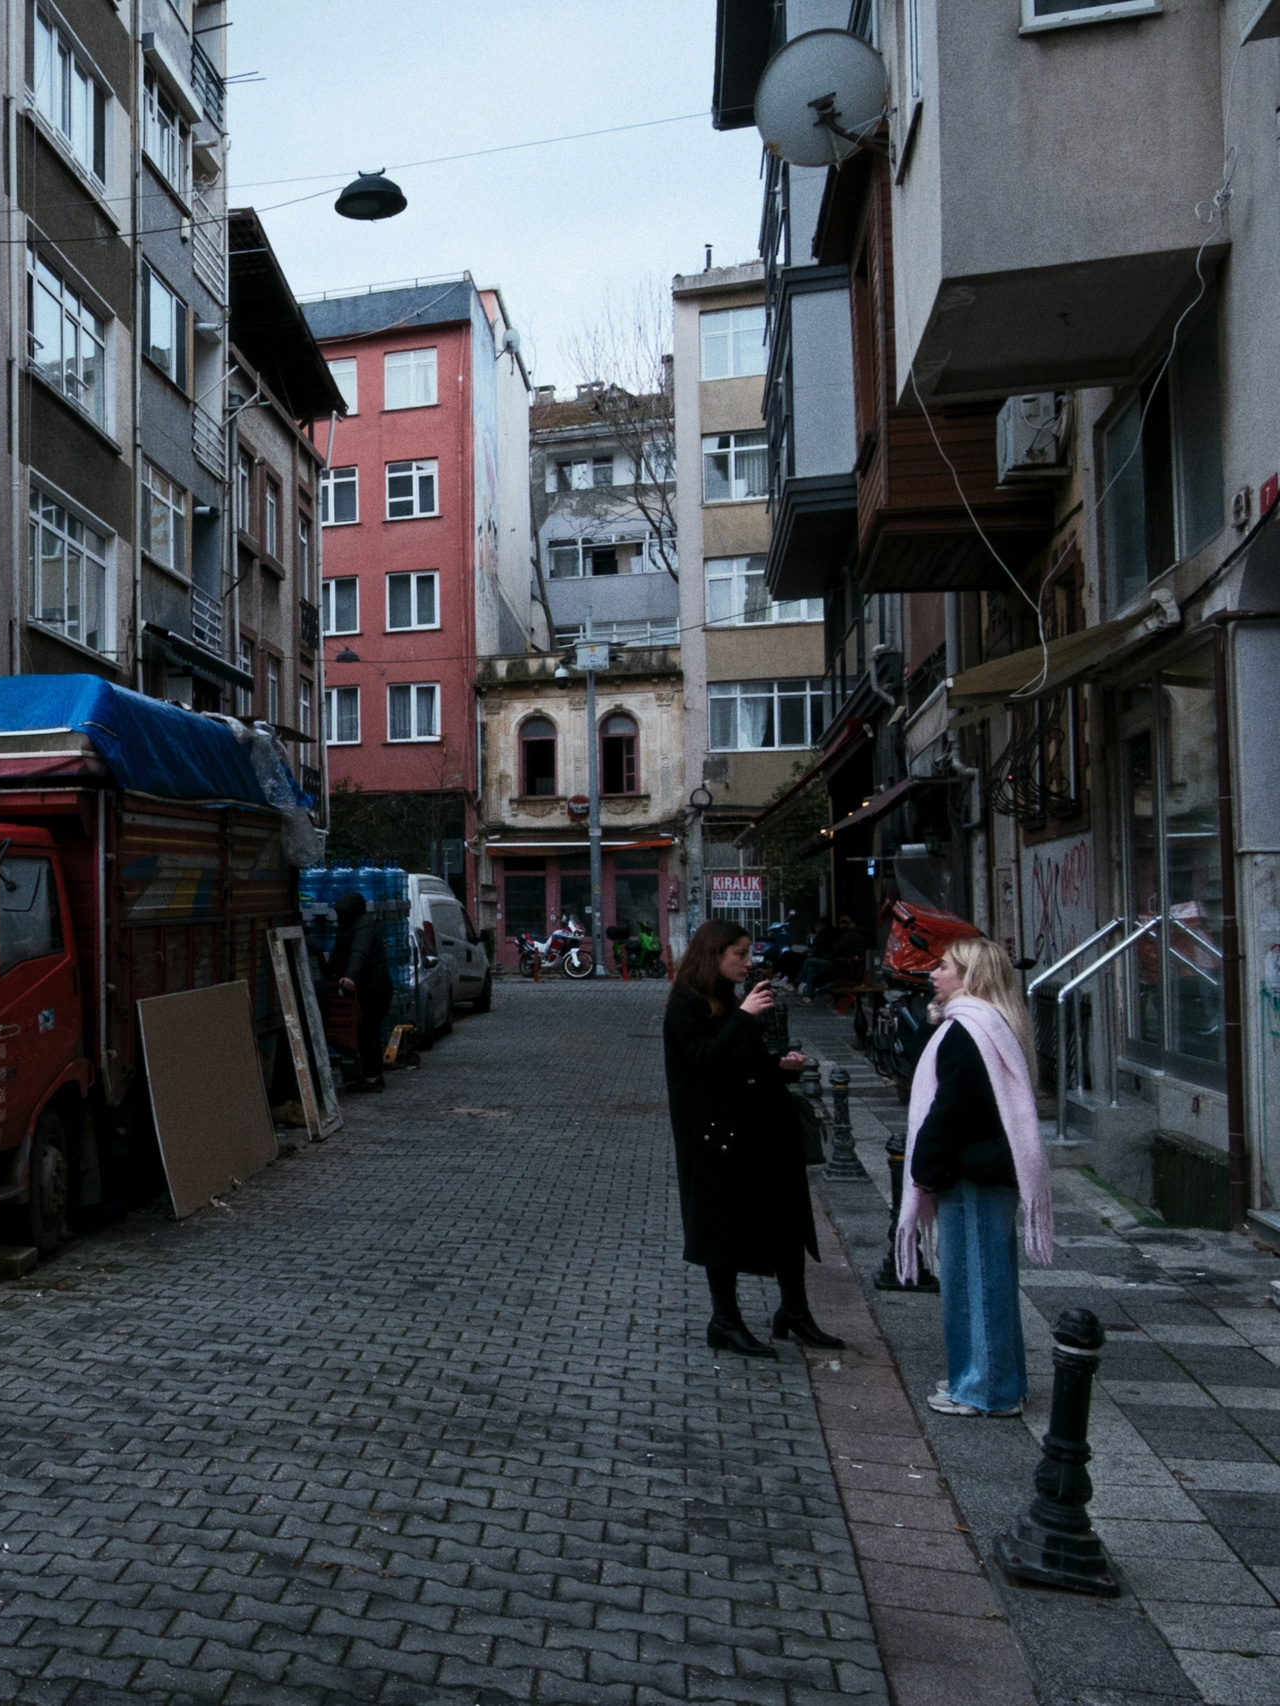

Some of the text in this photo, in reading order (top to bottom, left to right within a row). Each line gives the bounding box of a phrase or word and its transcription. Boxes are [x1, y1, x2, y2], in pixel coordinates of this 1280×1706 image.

[713, 891, 728, 901] 0532
[743, 891, 751, 901] 22
[752, 891, 760, 901] 00
